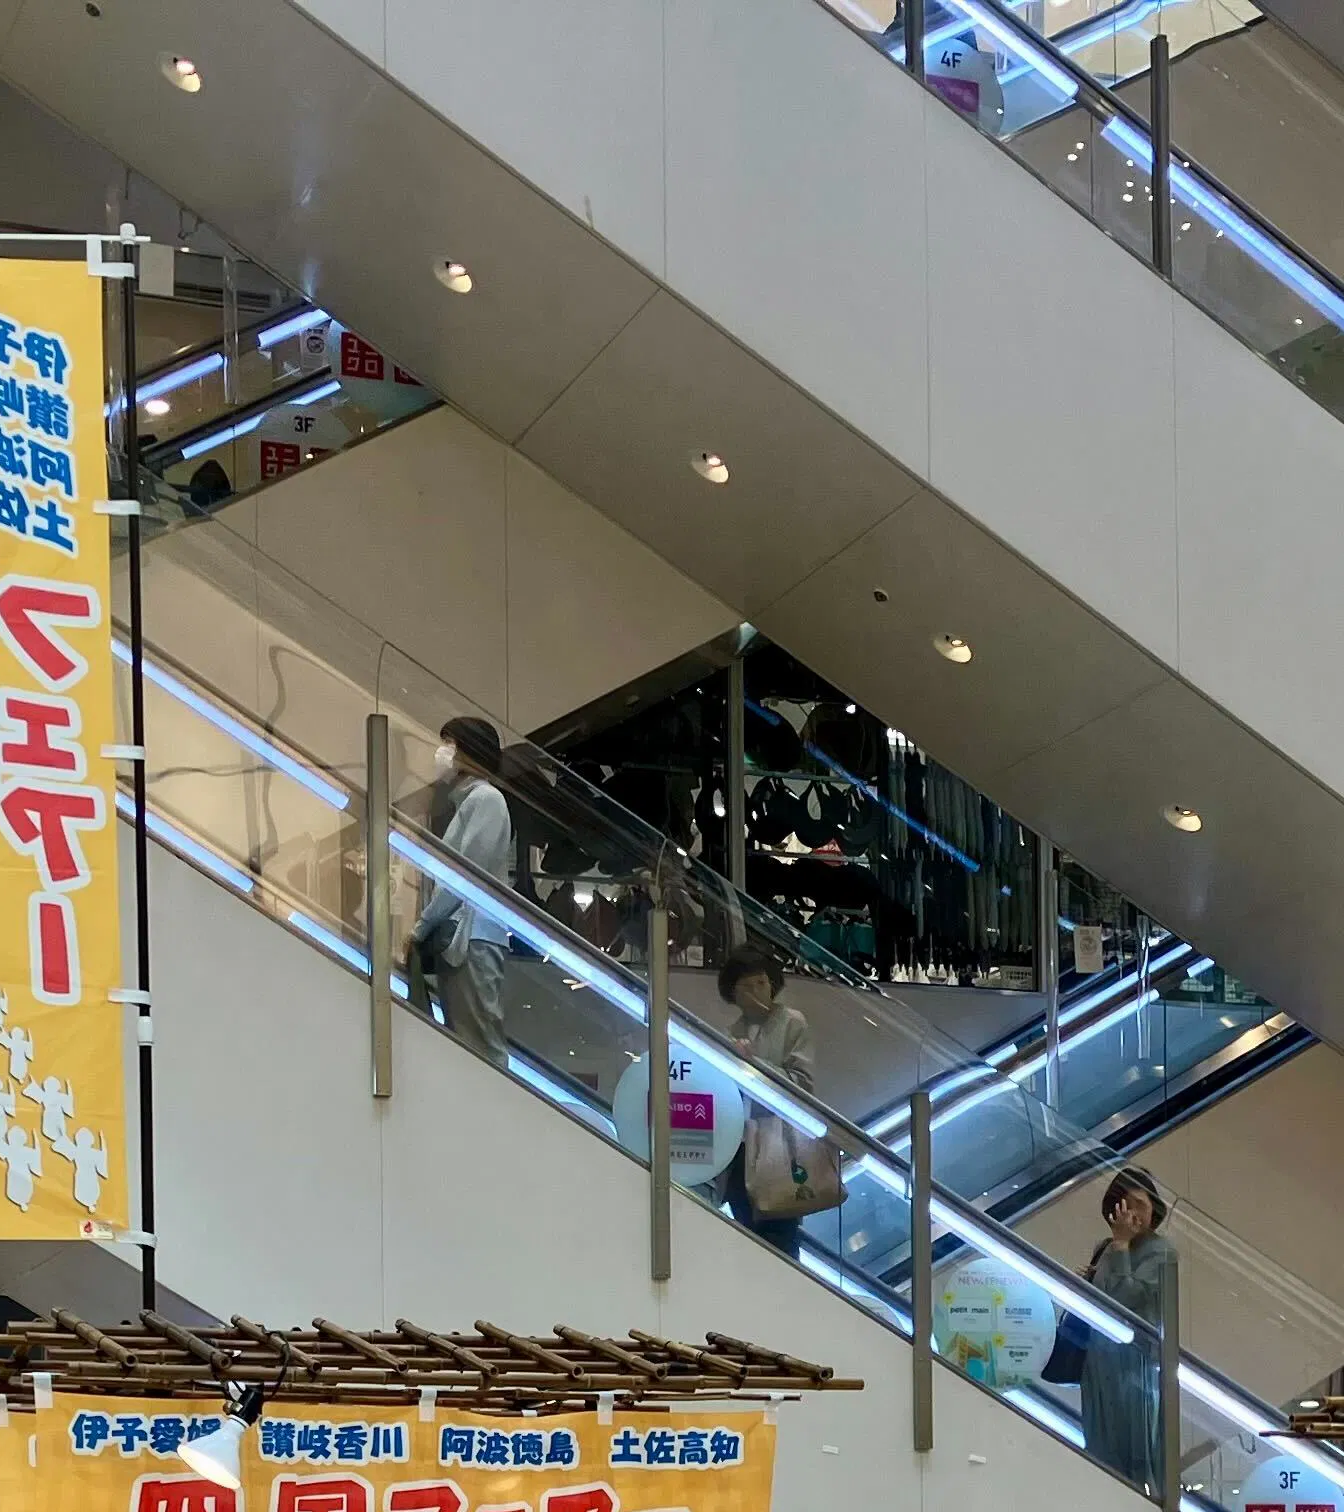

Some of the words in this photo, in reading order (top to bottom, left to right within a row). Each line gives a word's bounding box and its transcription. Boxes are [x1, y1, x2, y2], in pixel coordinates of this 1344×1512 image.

[940, 50, 963, 69] 4F
[294, 416, 316, 433] 3F
[668, 1061, 692, 1081] 4F
[261, 1422, 404, 1462] 讃岐香川
[441, 1428, 576, 1467] 阿波徳島
[611, 1431, 742, 1464] 土佐高知
[1278, 1471, 1301, 1490] 3F
